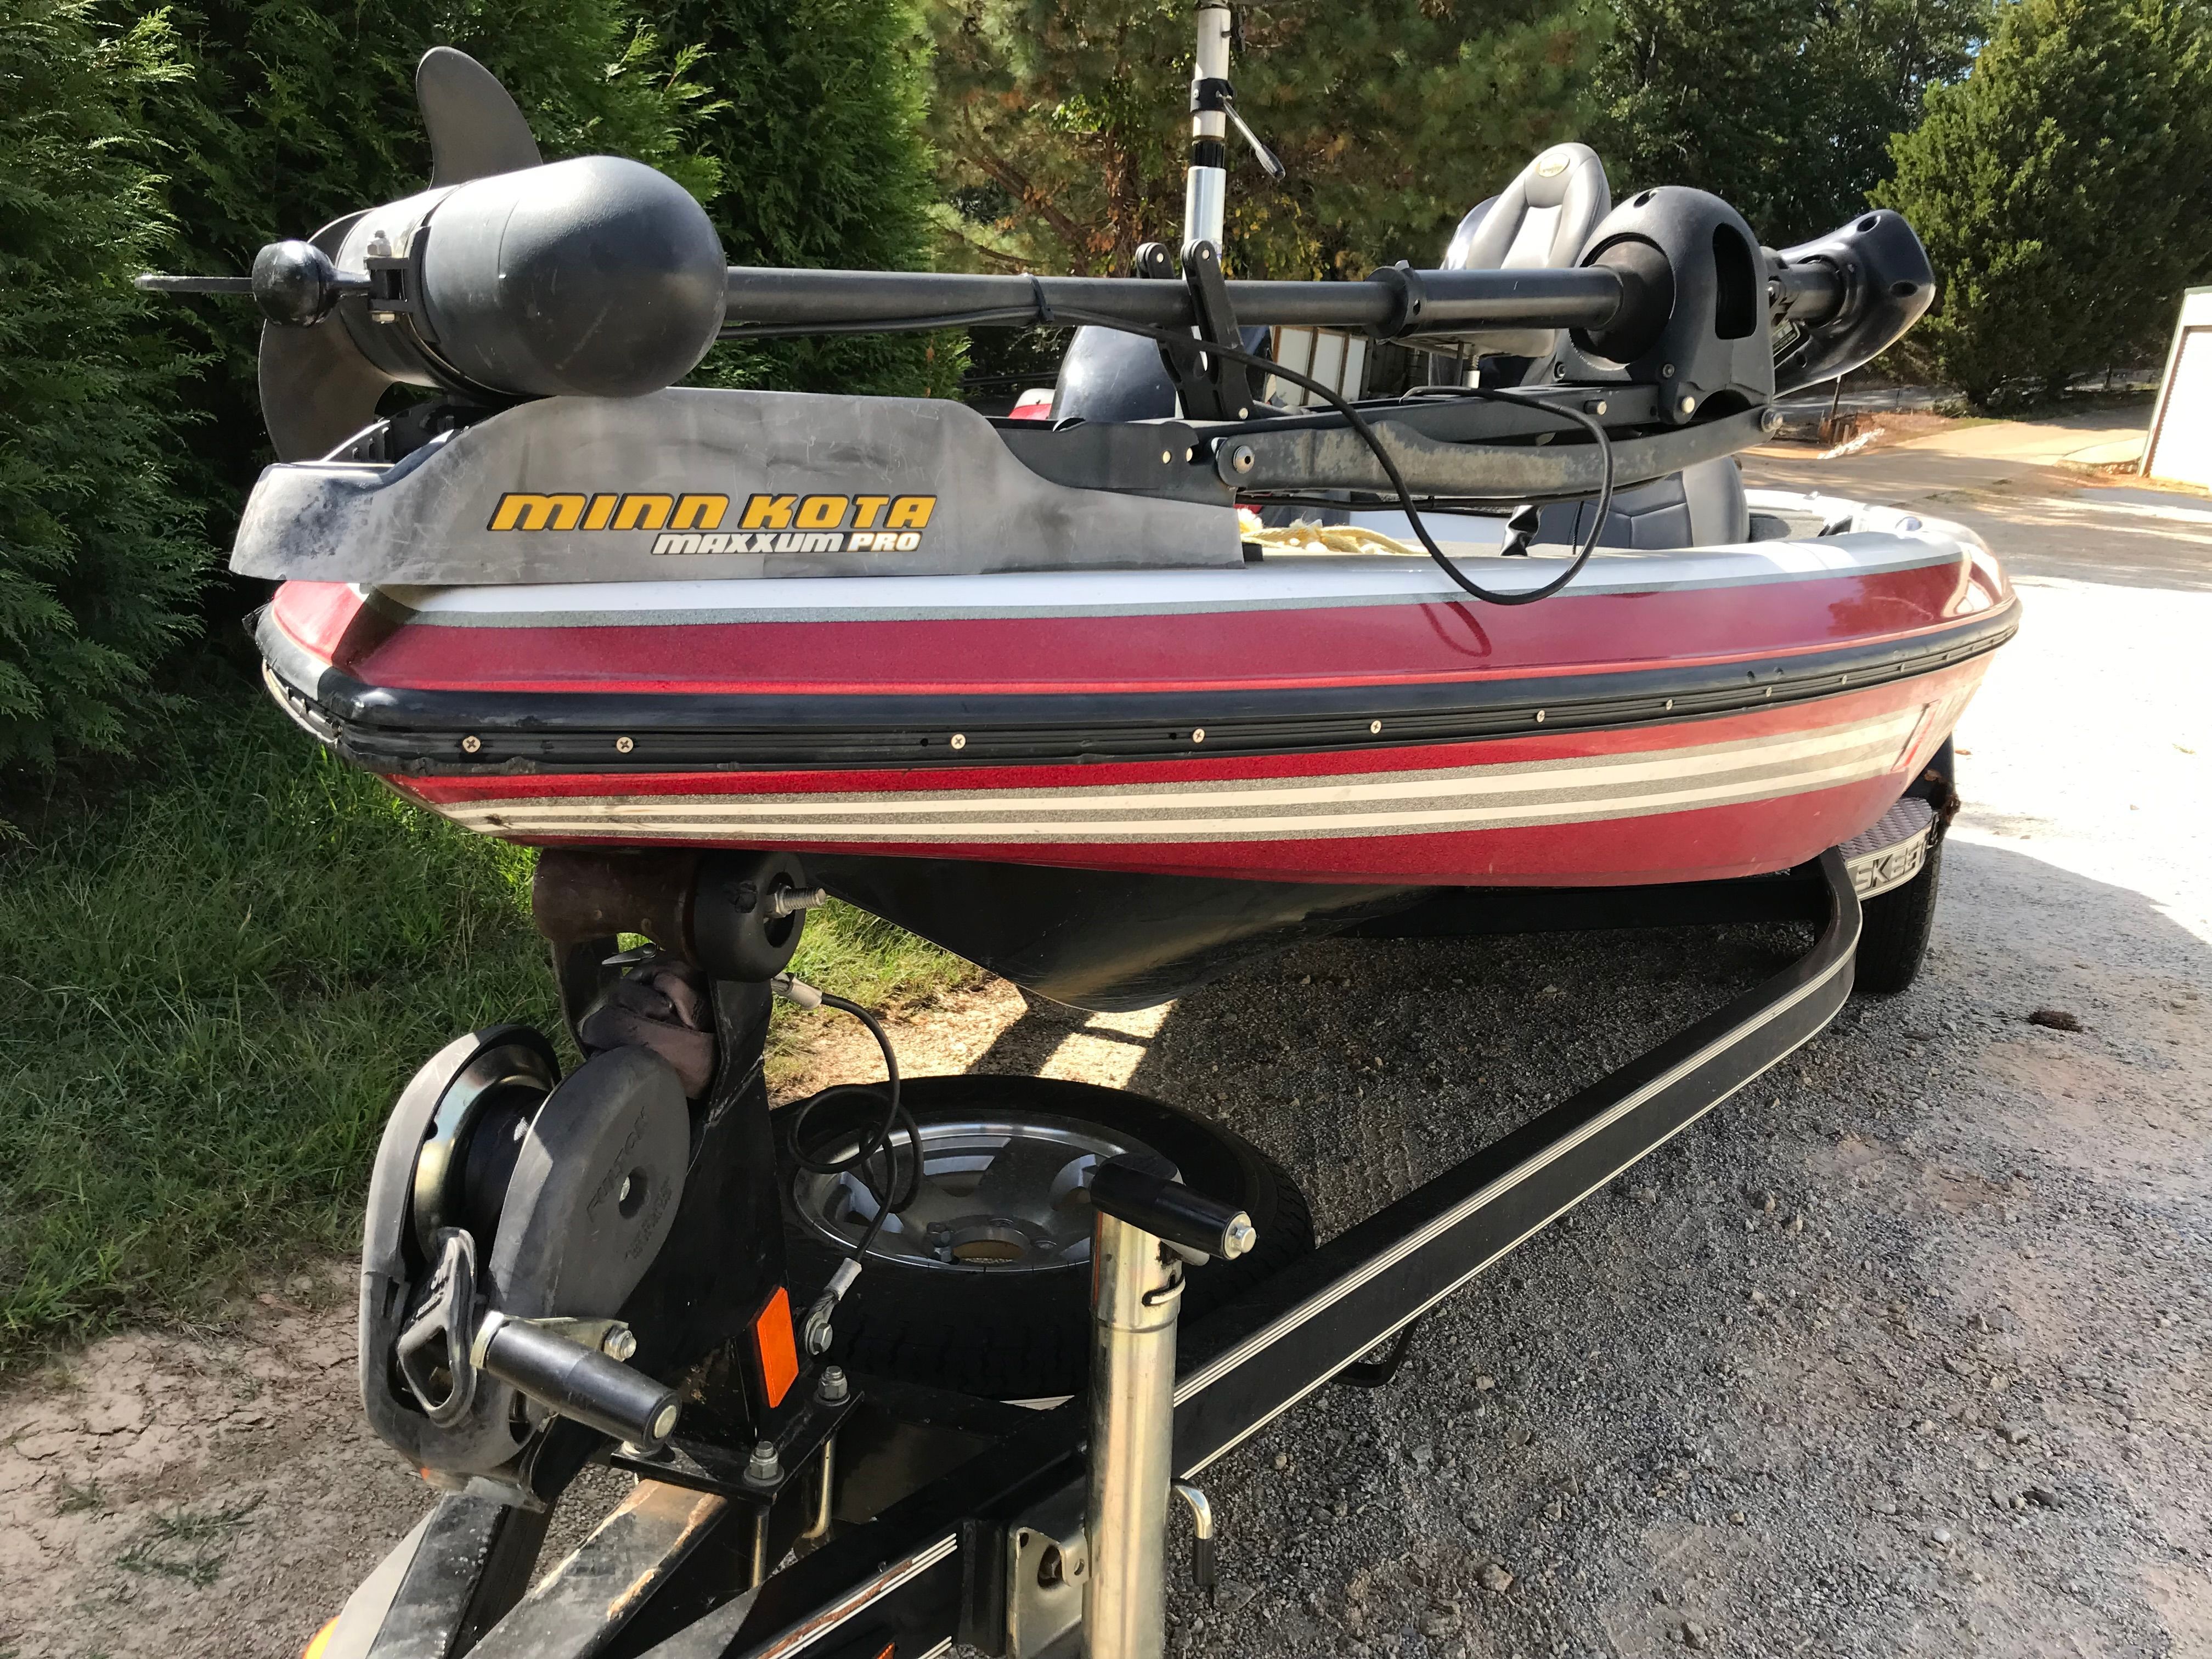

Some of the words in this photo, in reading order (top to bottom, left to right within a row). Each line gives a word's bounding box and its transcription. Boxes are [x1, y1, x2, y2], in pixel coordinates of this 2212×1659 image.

[487, 493, 730, 531] MINN
[737, 494, 938, 530] KOTA
[651, 532, 844, 555] MAXXUM
[846, 531, 924, 552] PRO
